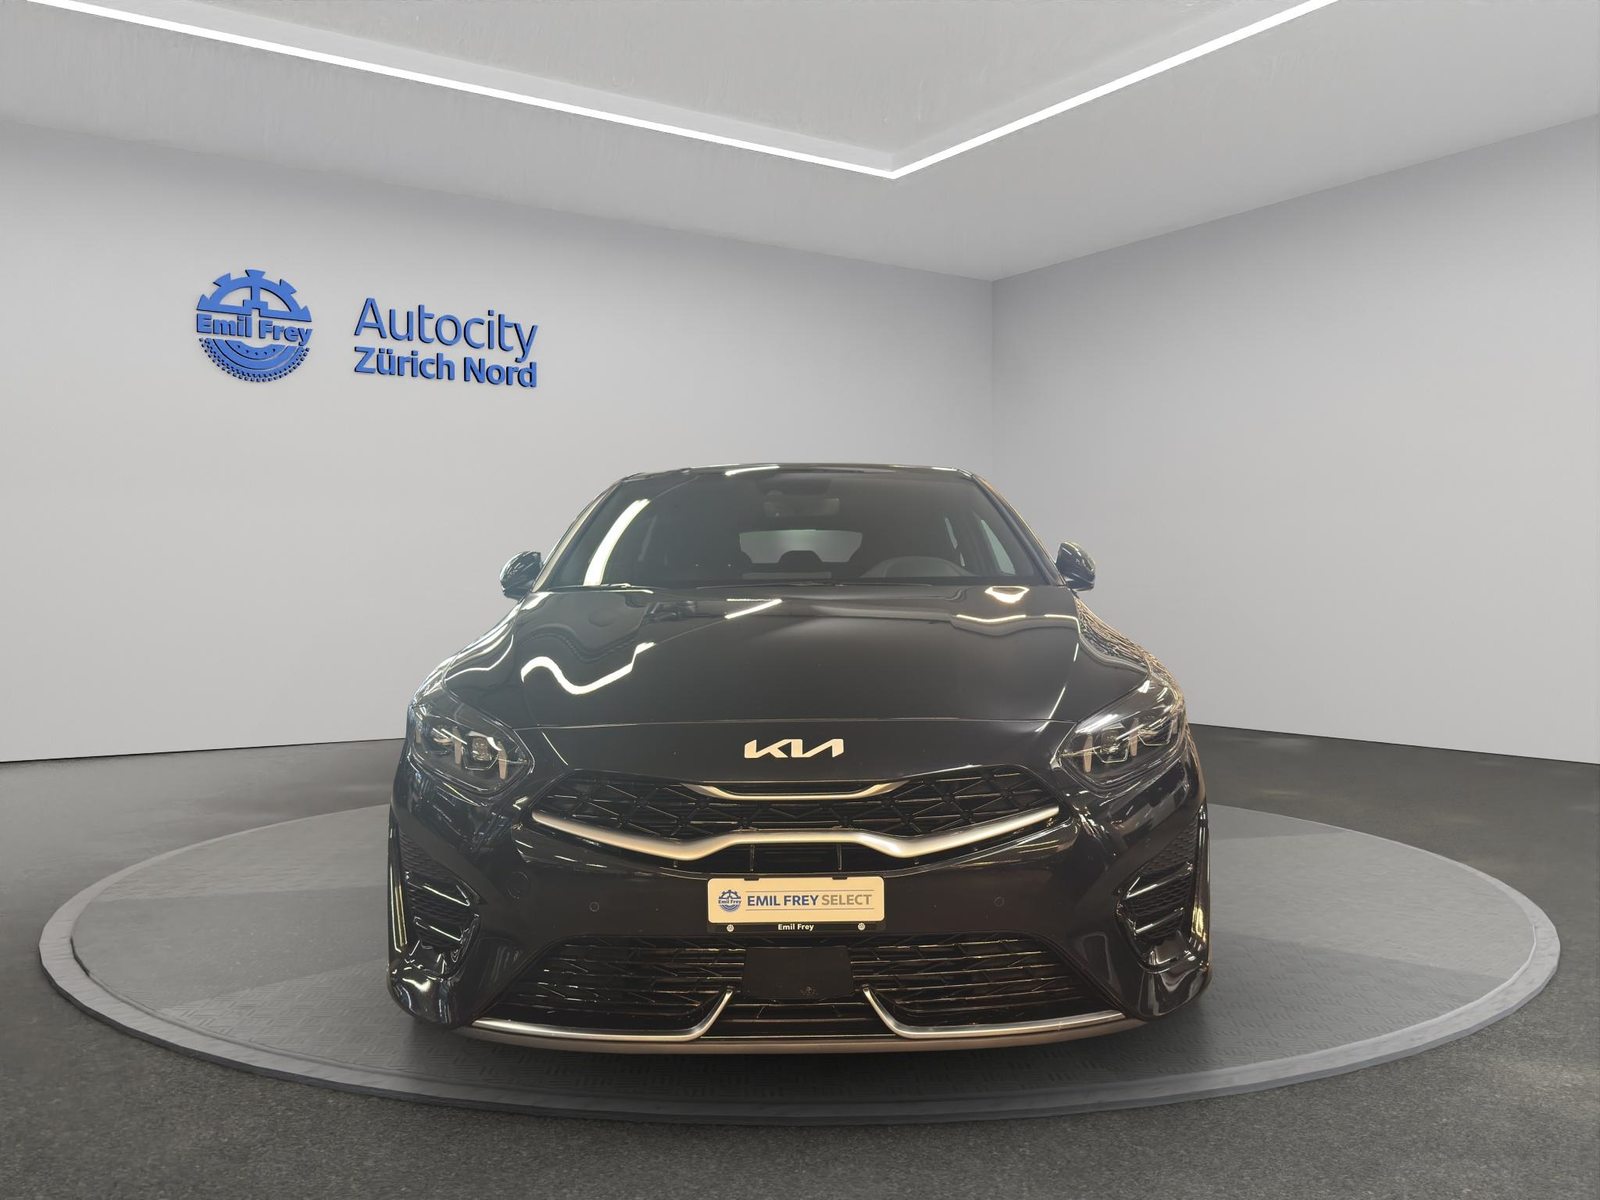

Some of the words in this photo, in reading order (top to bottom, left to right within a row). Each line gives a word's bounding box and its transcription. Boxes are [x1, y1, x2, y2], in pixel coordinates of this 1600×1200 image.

[196, 313, 252, 339] Emil
[258, 320, 313, 346] Frey
[354, 297, 539, 363] Autocity
[354, 345, 456, 380] Zürich
[463, 356, 538, 388] Nord
[744, 738, 844, 758] KIA
[747, 895, 781, 906] EMIL
[783, 894, 819, 906] FREY
[821, 894, 873, 905] SELECT
[777, 923, 796, 931] Emil
[797, 923, 815, 932] Frey
